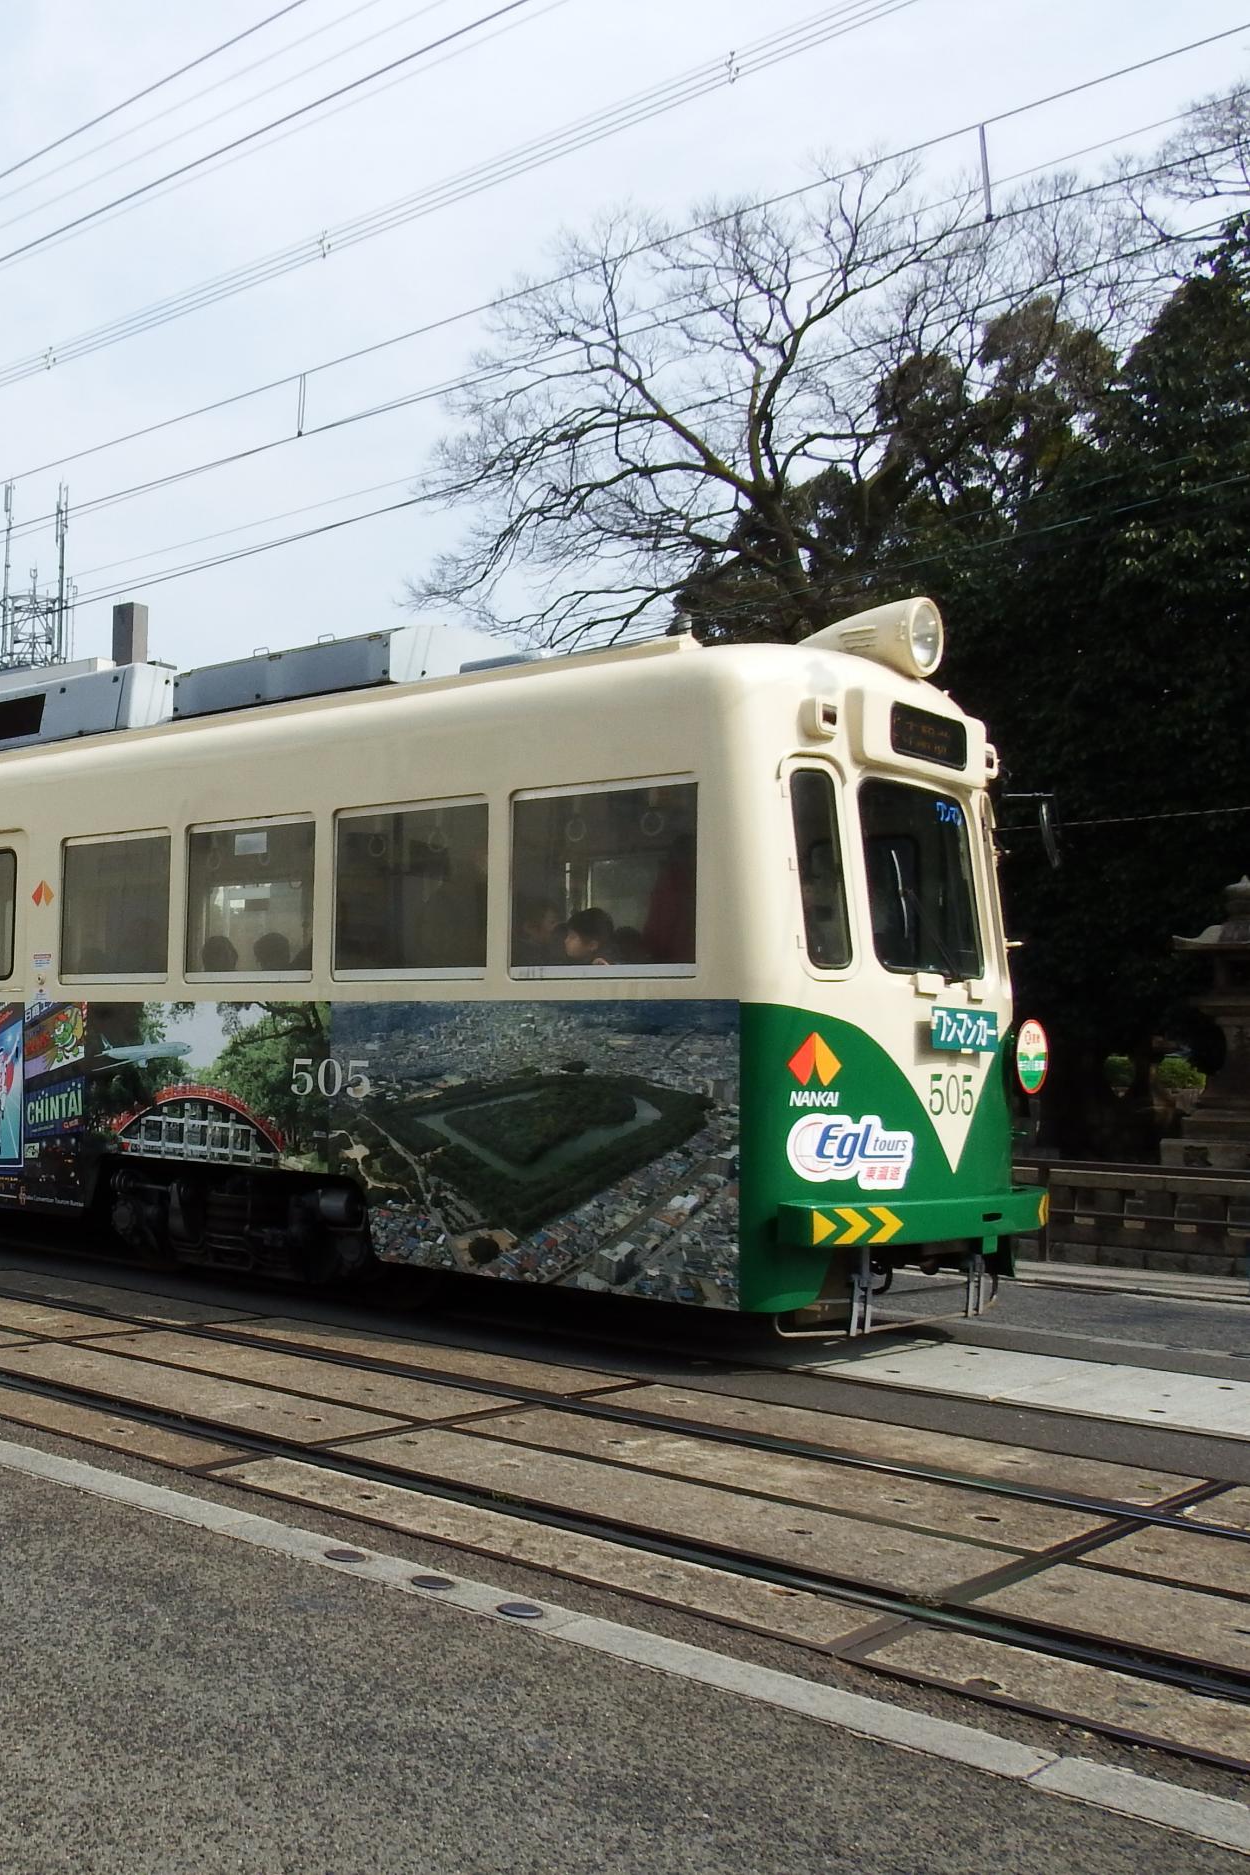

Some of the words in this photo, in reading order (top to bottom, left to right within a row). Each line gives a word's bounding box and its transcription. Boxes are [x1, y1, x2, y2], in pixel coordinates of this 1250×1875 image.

[932, 1009, 997, 1046] ワンマンカー
[290, 1058, 371, 1098] 505
[929, 1073, 974, 1116] 505
[789, 1090, 840, 1107] NANKAI
[815, 1124, 873, 1167] Egl
[872, 1136, 908, 1152] tours
